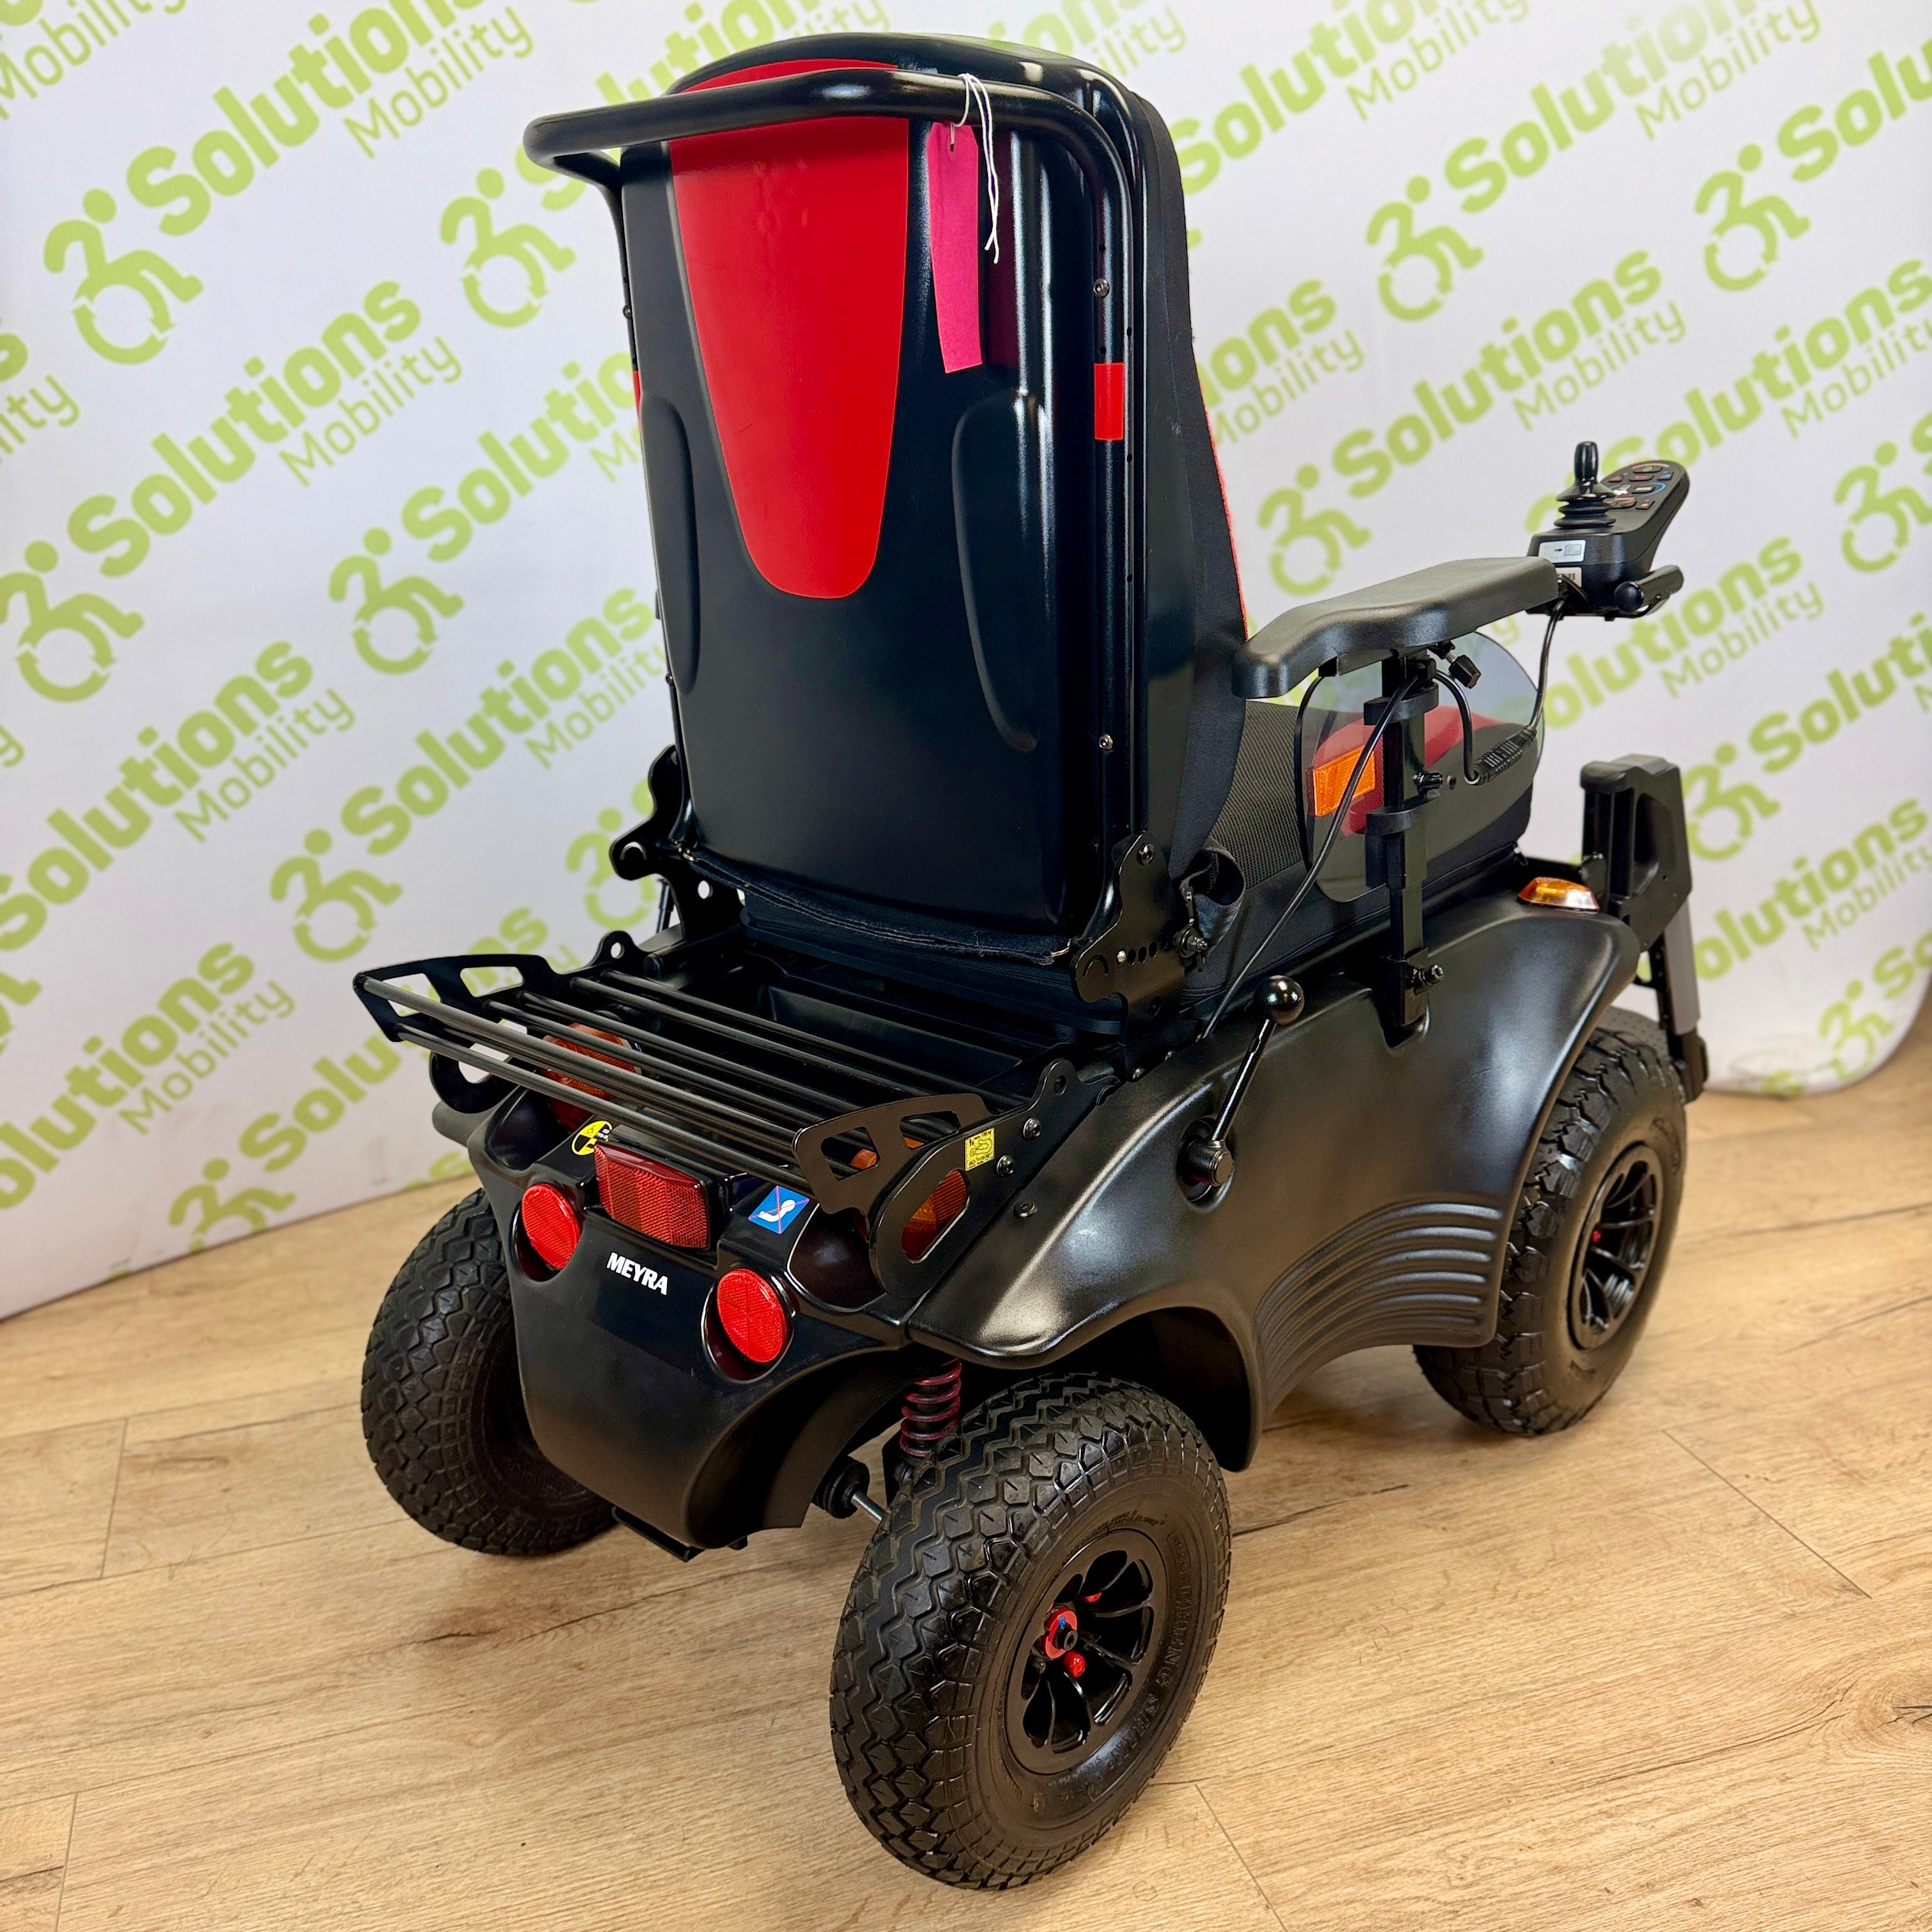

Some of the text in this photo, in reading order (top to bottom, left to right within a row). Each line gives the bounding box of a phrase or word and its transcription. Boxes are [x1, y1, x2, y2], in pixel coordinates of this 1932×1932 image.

[126, 0, 484, 236] Solution
[343, 7, 533, 157] Mobility
[67, 280, 421, 578] Solutions
[279, 337, 462, 486] Mobility
[1331, 250, 1662, 498] Solutions
[1513, 303, 1685, 429] Mobility
[1662, 583, 1825, 697] Mobility
[174, 689, 355, 841] Mobility
[341, 588, 654, 855] Solutions
[0, 942, 254, 1209] olutions
[119, 981, 295, 1133] Mobility
[606, 1252, 668, 1296] MEYRA
